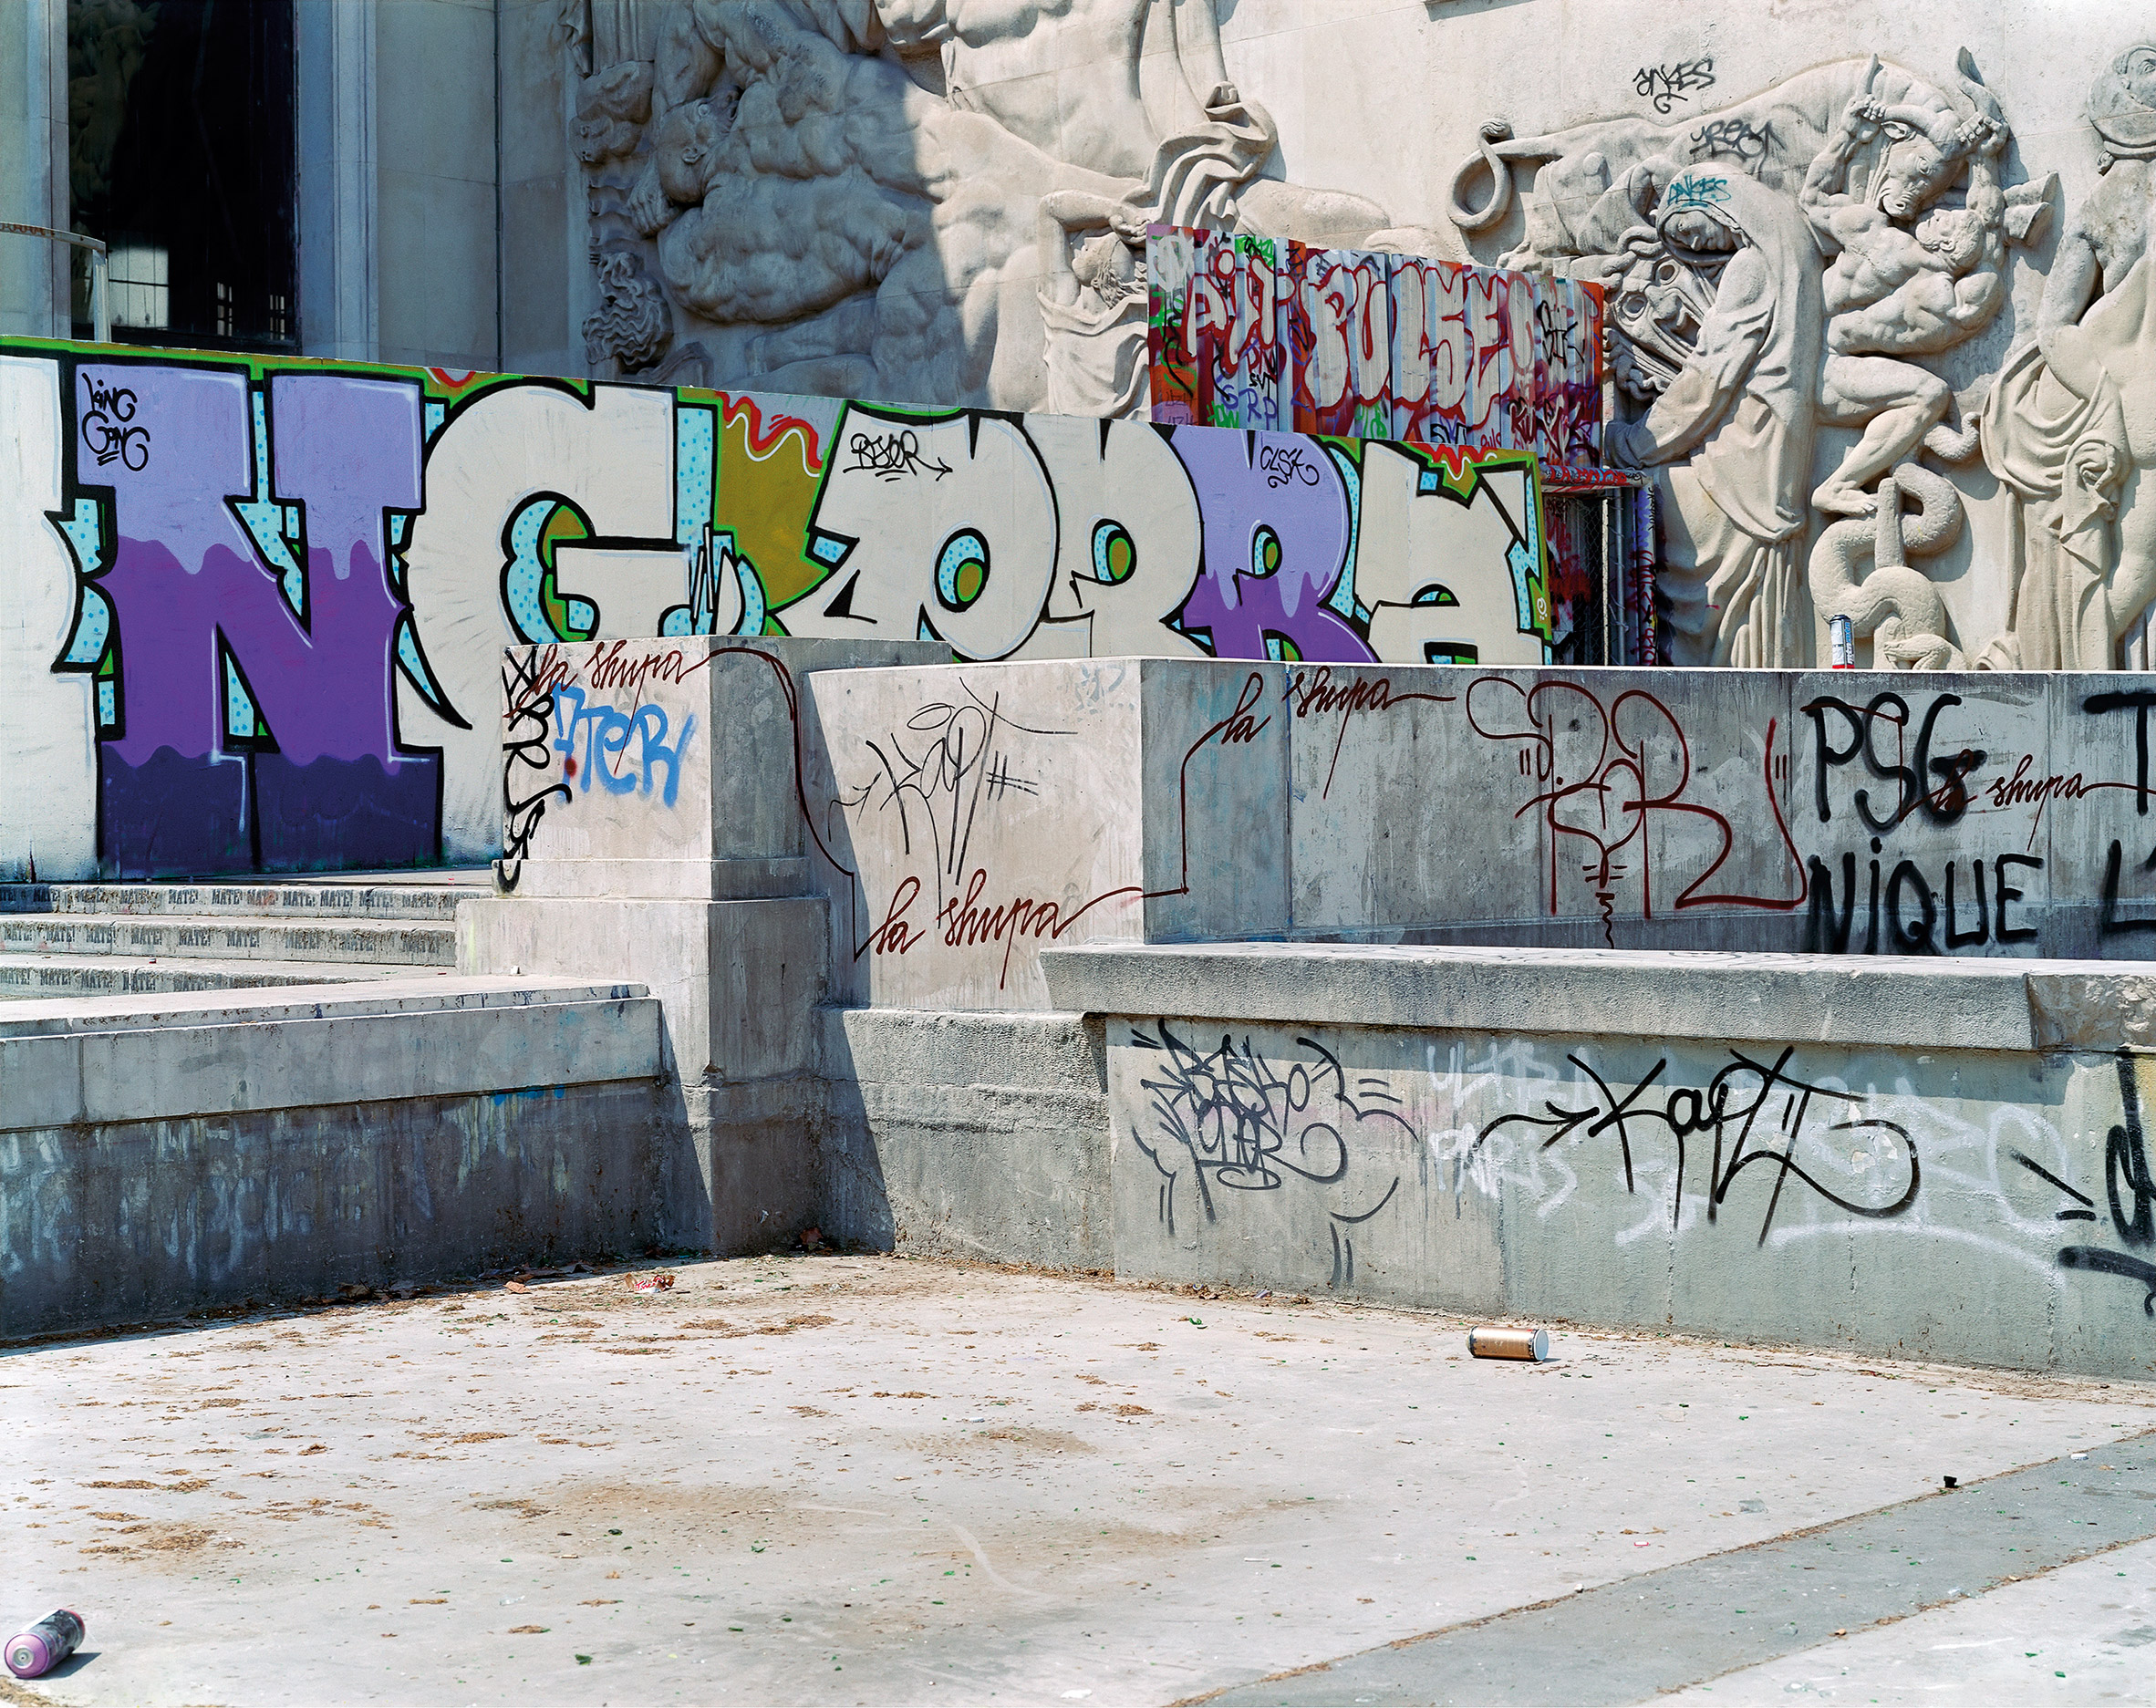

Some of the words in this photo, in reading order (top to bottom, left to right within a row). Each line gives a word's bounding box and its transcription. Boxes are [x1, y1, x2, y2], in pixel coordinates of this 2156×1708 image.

[1800, 692, 1986, 830] PSG
[168, 888, 199, 905] MATE!
[212, 888, 243, 906] MATE!
[283, 890, 316, 906] MATE!
[319, 889, 354, 907] MATE!
[226, 930, 260, 948] MATE!
